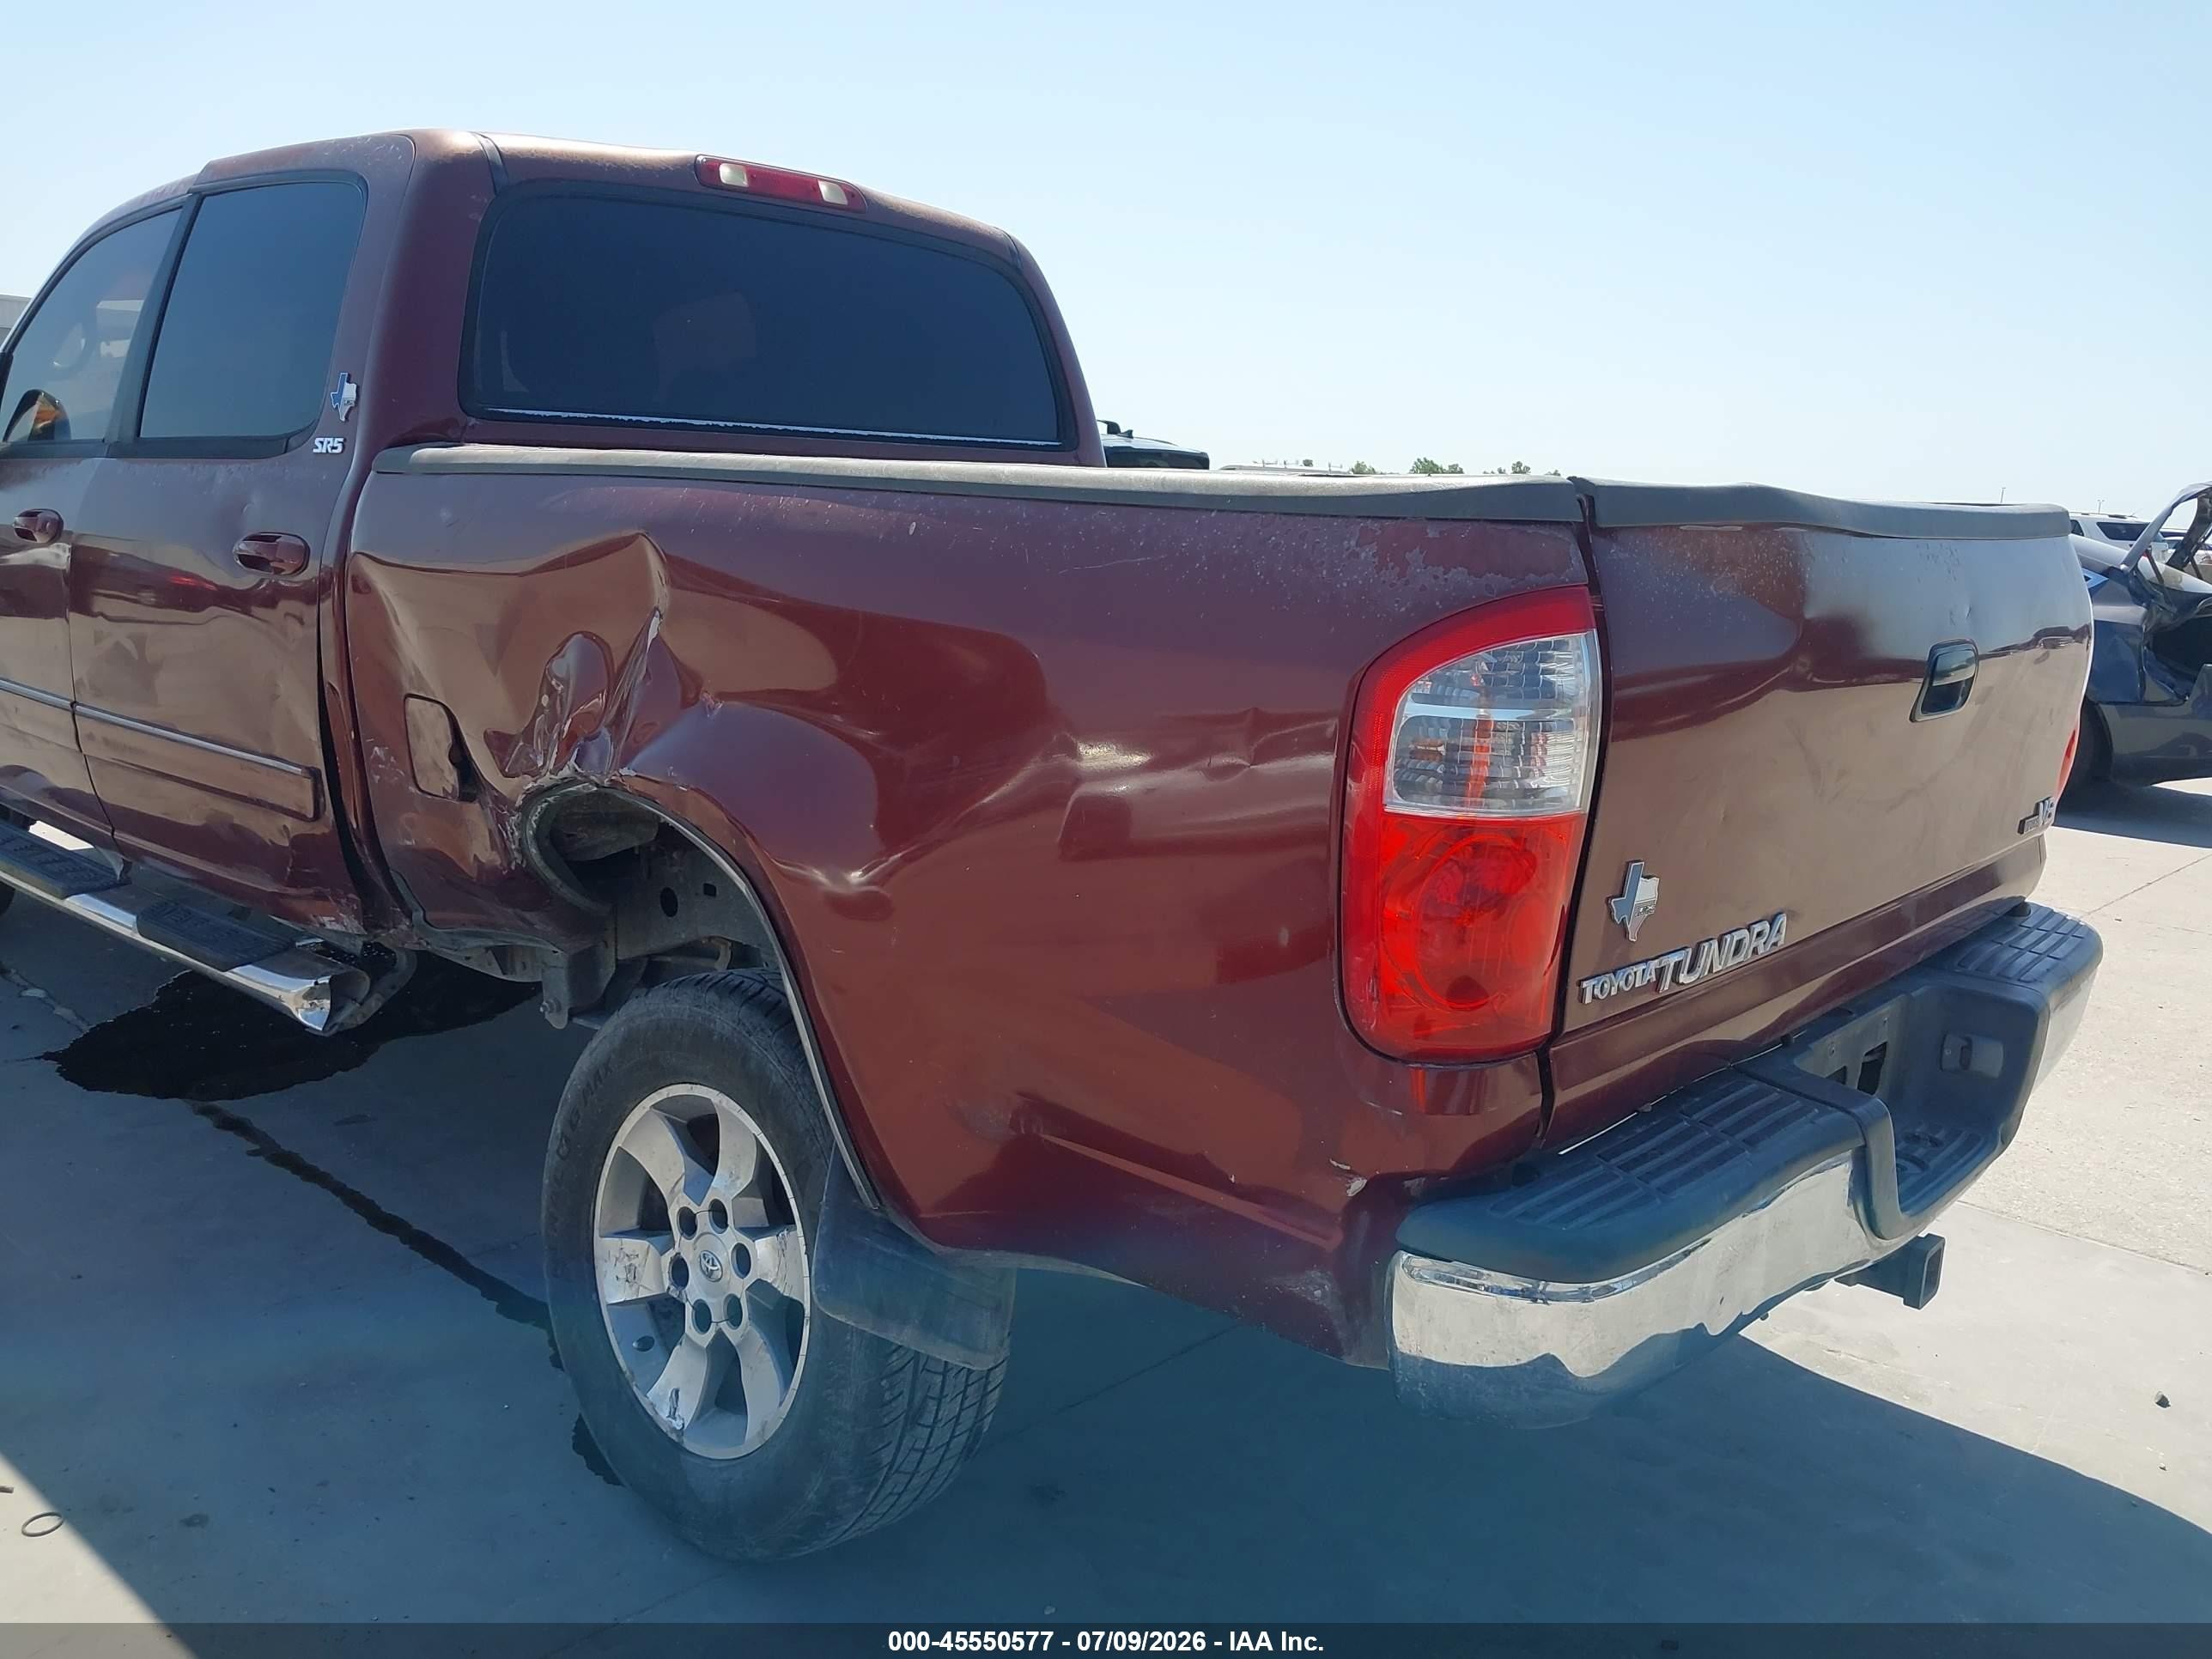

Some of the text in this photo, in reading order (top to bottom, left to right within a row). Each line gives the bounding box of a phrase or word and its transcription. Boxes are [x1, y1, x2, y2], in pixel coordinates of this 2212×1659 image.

[313, 437, 344, 453] SR5
[1580, 912, 1788, 1004] TOYOTA TUNDRA
